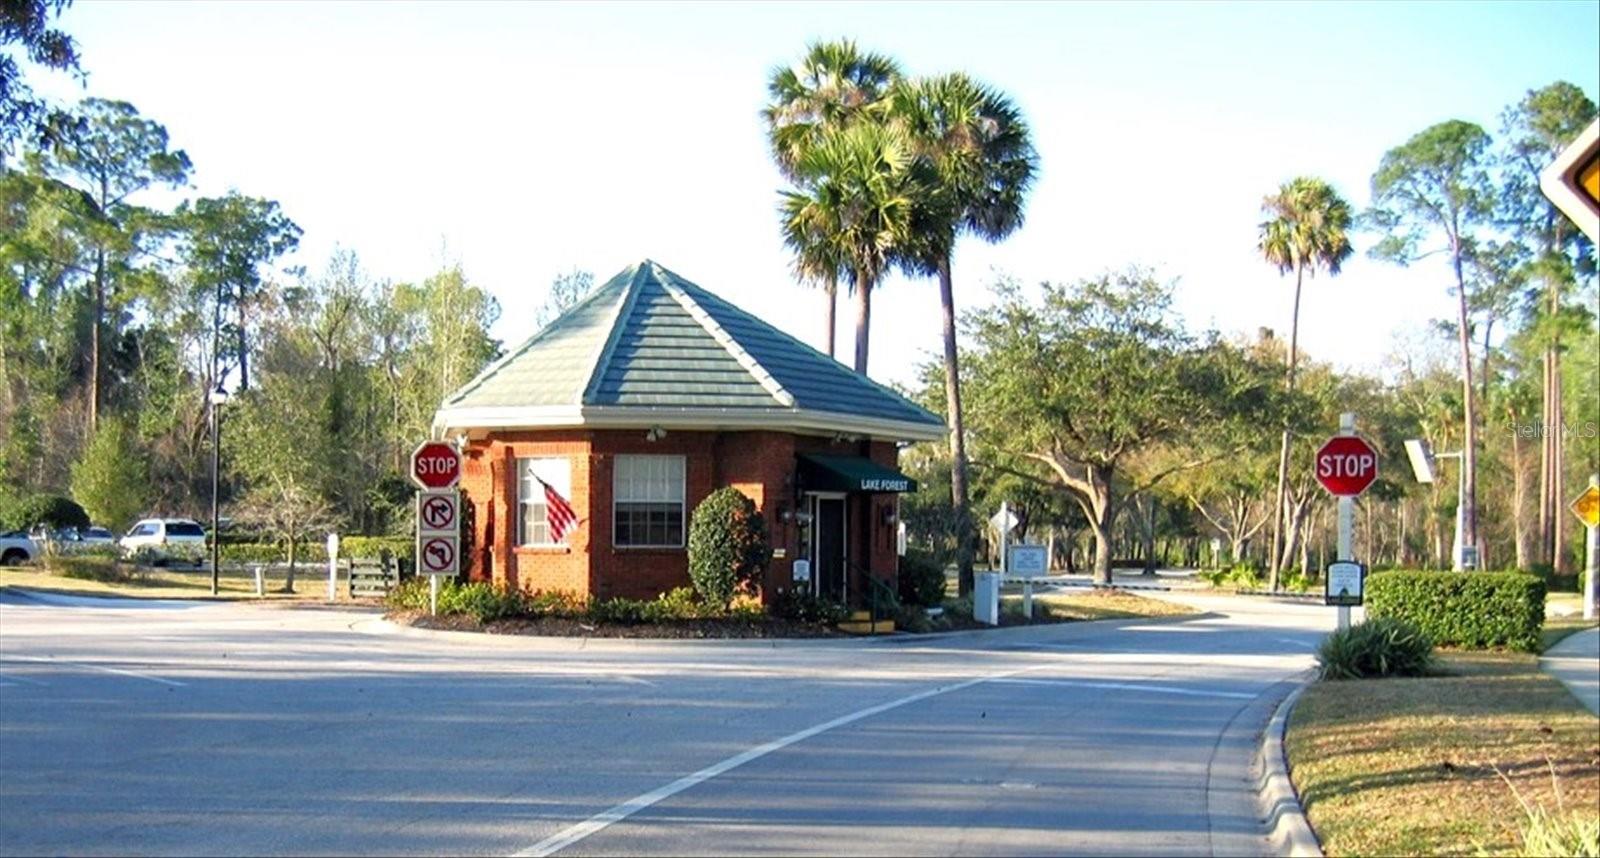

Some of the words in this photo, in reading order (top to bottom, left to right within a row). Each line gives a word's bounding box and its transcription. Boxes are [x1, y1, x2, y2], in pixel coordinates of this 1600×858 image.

[418, 457, 456, 474] STOP
[1319, 454, 1373, 478] STOP
[861, 479, 881, 490] LAKE
[881, 480, 908, 491] FOREST
